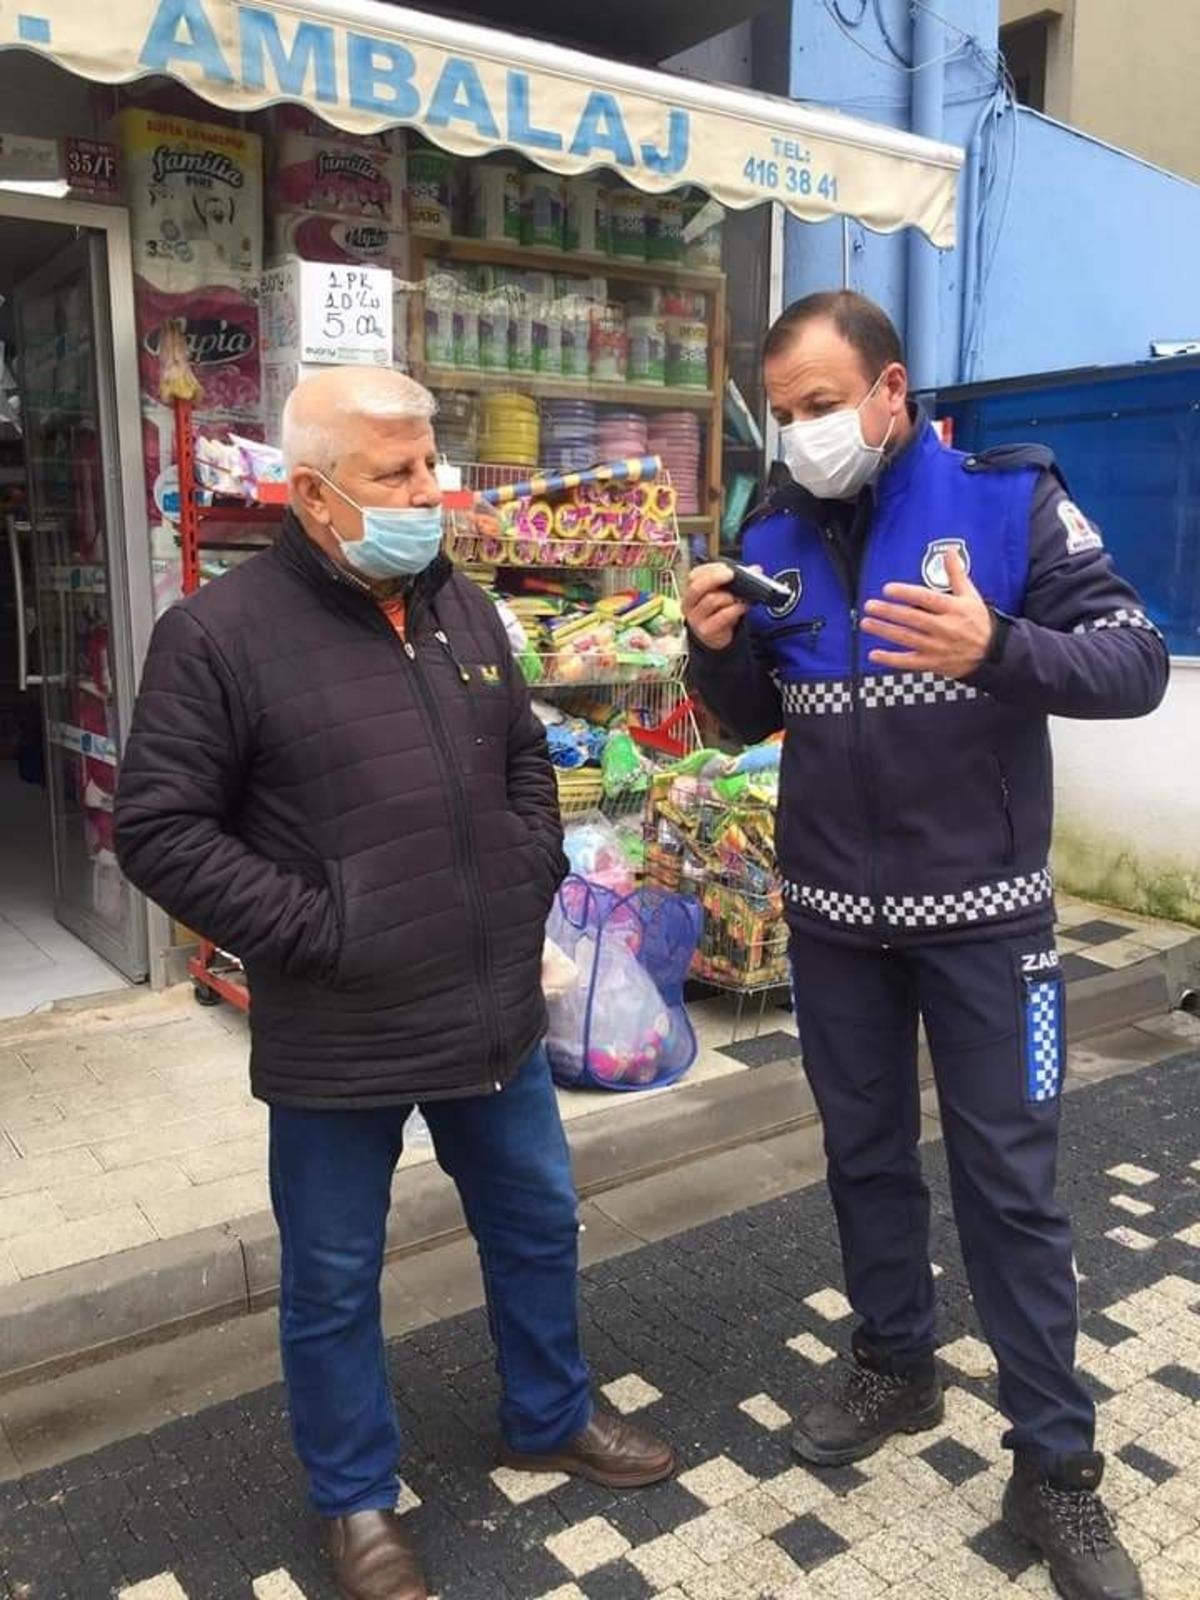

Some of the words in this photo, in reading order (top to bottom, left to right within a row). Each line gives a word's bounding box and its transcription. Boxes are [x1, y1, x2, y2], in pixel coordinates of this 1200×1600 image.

[138, 0, 690, 175] AMBALAJ
[152, 145, 243, 188] familia
[318, 150, 380, 183] familia
[771, 138, 811, 162] TEL:
[743, 156, 778, 188] 416
[786, 166, 812, 195] 38
[817, 173, 838, 202] 41
[329, 271, 342, 288] 1
